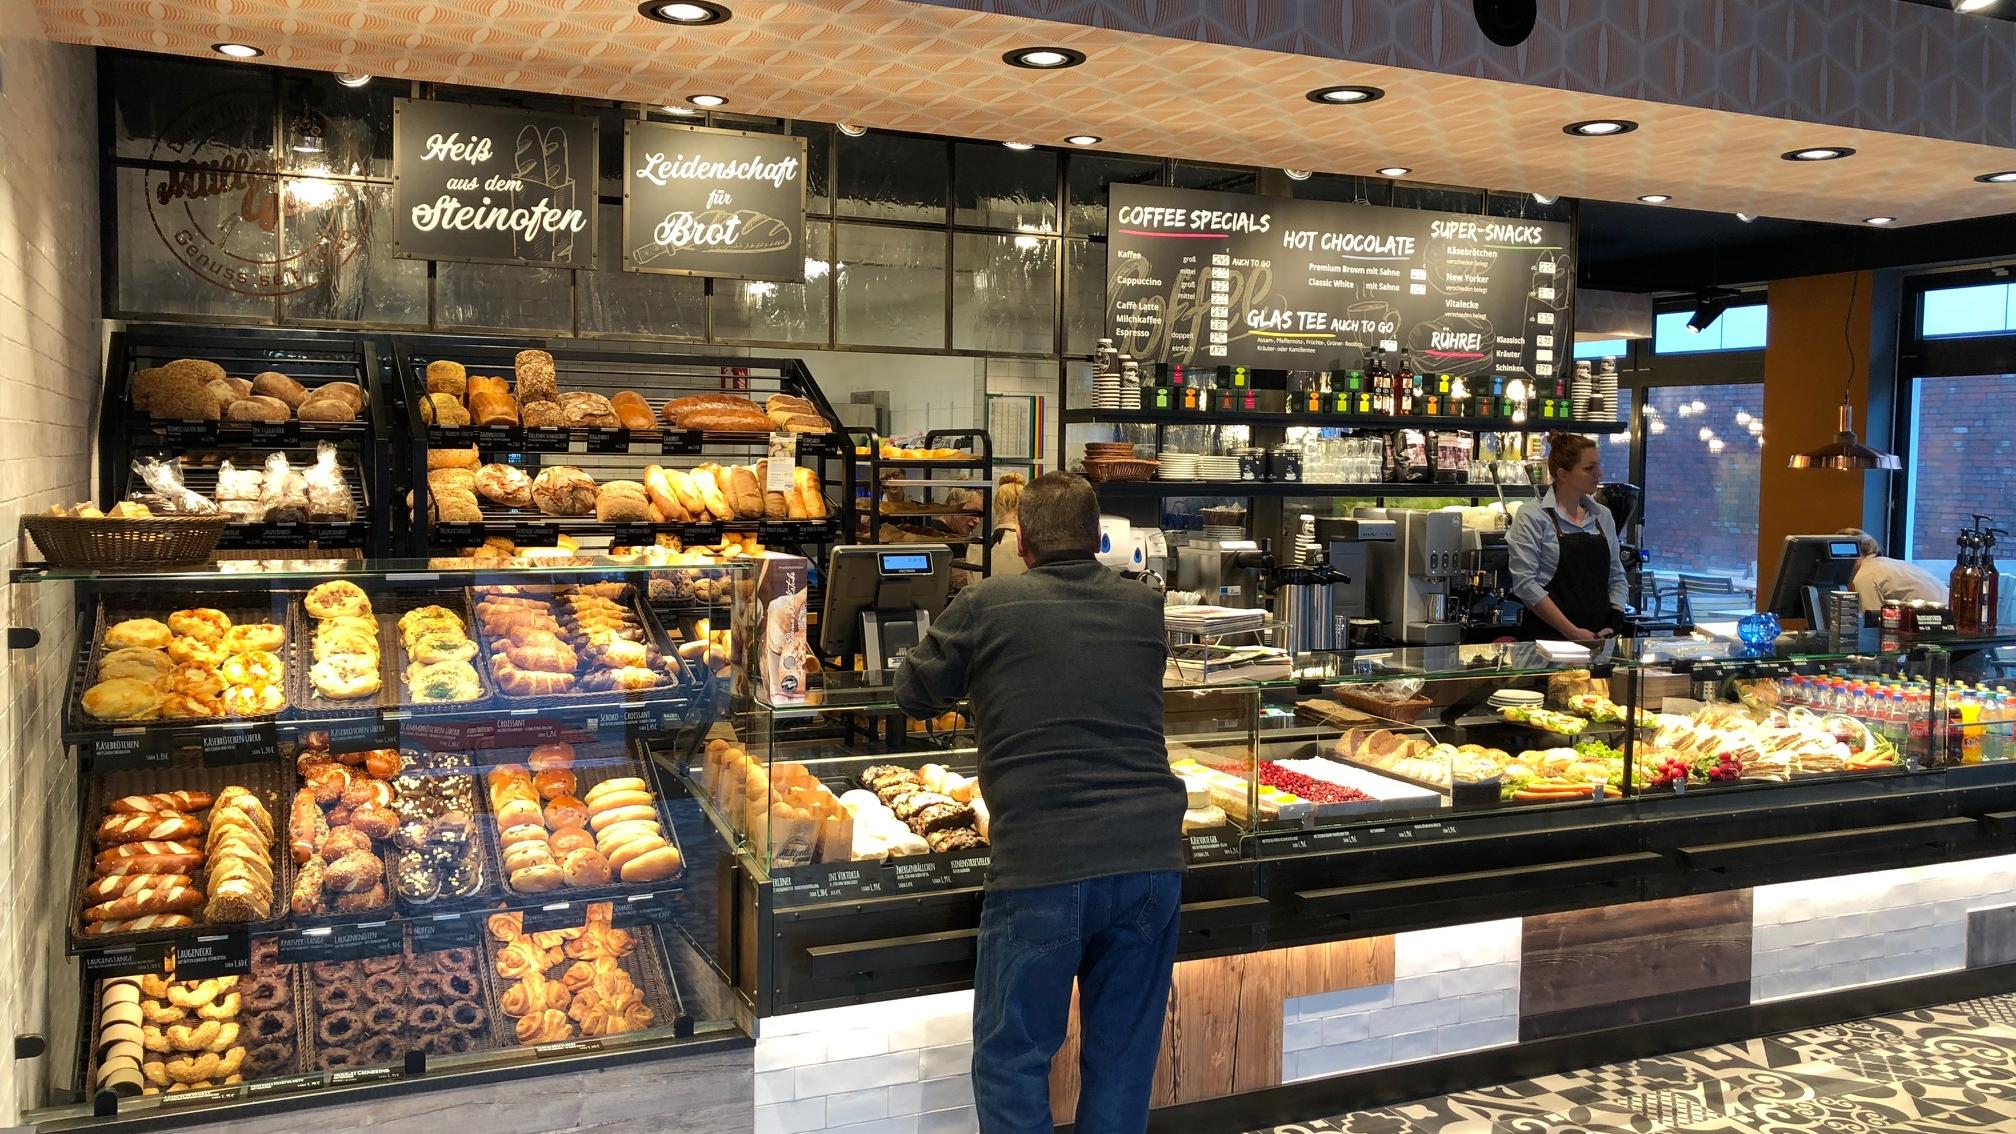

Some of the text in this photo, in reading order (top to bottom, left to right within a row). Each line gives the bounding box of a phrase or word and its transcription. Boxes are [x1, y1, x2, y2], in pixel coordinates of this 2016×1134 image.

[420, 132, 493, 165] Heiß
[635, 152, 799, 188] Leidenschaft
[446, 174, 523, 191] aus dem
[705, 189, 732, 209] für
[411, 194, 587, 241] Steinofen
[1118, 205, 1271, 234] COFFEE SPECIALS
[653, 210, 742, 246] Brot
[1431, 220, 1543, 244] SUPER-SNACKS
[1283, 230, 1416, 256] HOT CHOCOLATE
[174, 229, 248, 284] Genuss
[1447, 246, 1498, 258] Käsebrötchen
[1117, 250, 1142, 259] Kaffee
[1182, 255, 1197, 264] groß
[1232, 258, 1249, 267] AUCH
[1251, 259, 1260, 267] TO
[1260, 260, 1271, 268] GO
[1308, 263, 1400, 277] Premium Brown mit Sahne
[1117, 276, 1162, 287] Cappuccino
[1181, 280, 1196, 289] groß
[1446, 272, 1489, 283] New Yorker
[1308, 278, 1400, 291] Classic White mit Sahne
[1178, 292, 1196, 300] mittel
[1116, 301, 1138, 310] Caffè
[1138, 303, 1160, 311] Latte
[1445, 299, 1480, 309] Vitalecke
[1116, 314, 1162, 325] Milchkaffee
[1247, 309, 1394, 334] GLAS TEE AUCH TO GO
[1116, 328, 1150, 338] Espresso
[1171, 331, 1194, 340] doppelt
[1430, 327, 1481, 350] RÜHREI
[1496, 336, 1526, 345] Klassisch
[1172, 344, 1194, 352] einfach
[1496, 350, 1521, 358] Kräuter
[1495, 364, 1525, 372] Schinken
[624, 710, 651, 721] CROISSANT
[497, 719, 525, 728] CROISSANT
[95, 740, 140, 751] KÄSEBRÖTCHEN
[203, 735, 245, 748] KÄSEBRÖTCHEN
[177, 946, 213, 959] LAUGENECKE
